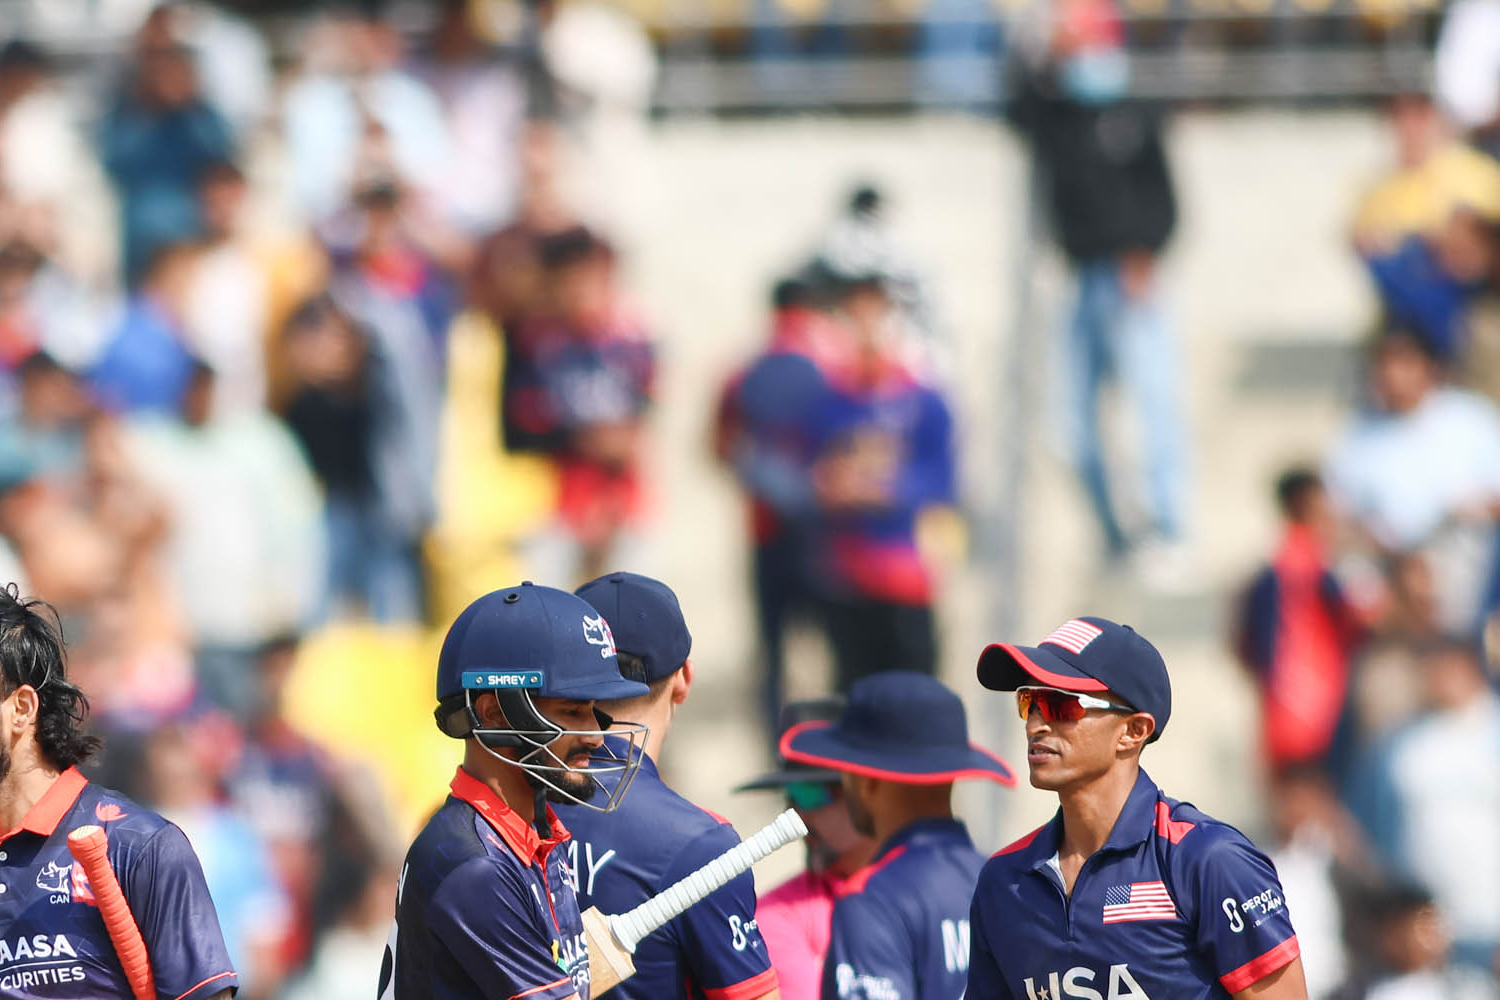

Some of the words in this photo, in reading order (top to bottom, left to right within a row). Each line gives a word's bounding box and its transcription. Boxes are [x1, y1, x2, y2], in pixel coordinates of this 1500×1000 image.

[488, 675, 526, 686] SHREY
[50, 895, 70, 904] CAN
[1241, 889, 1273, 913] PEROT
